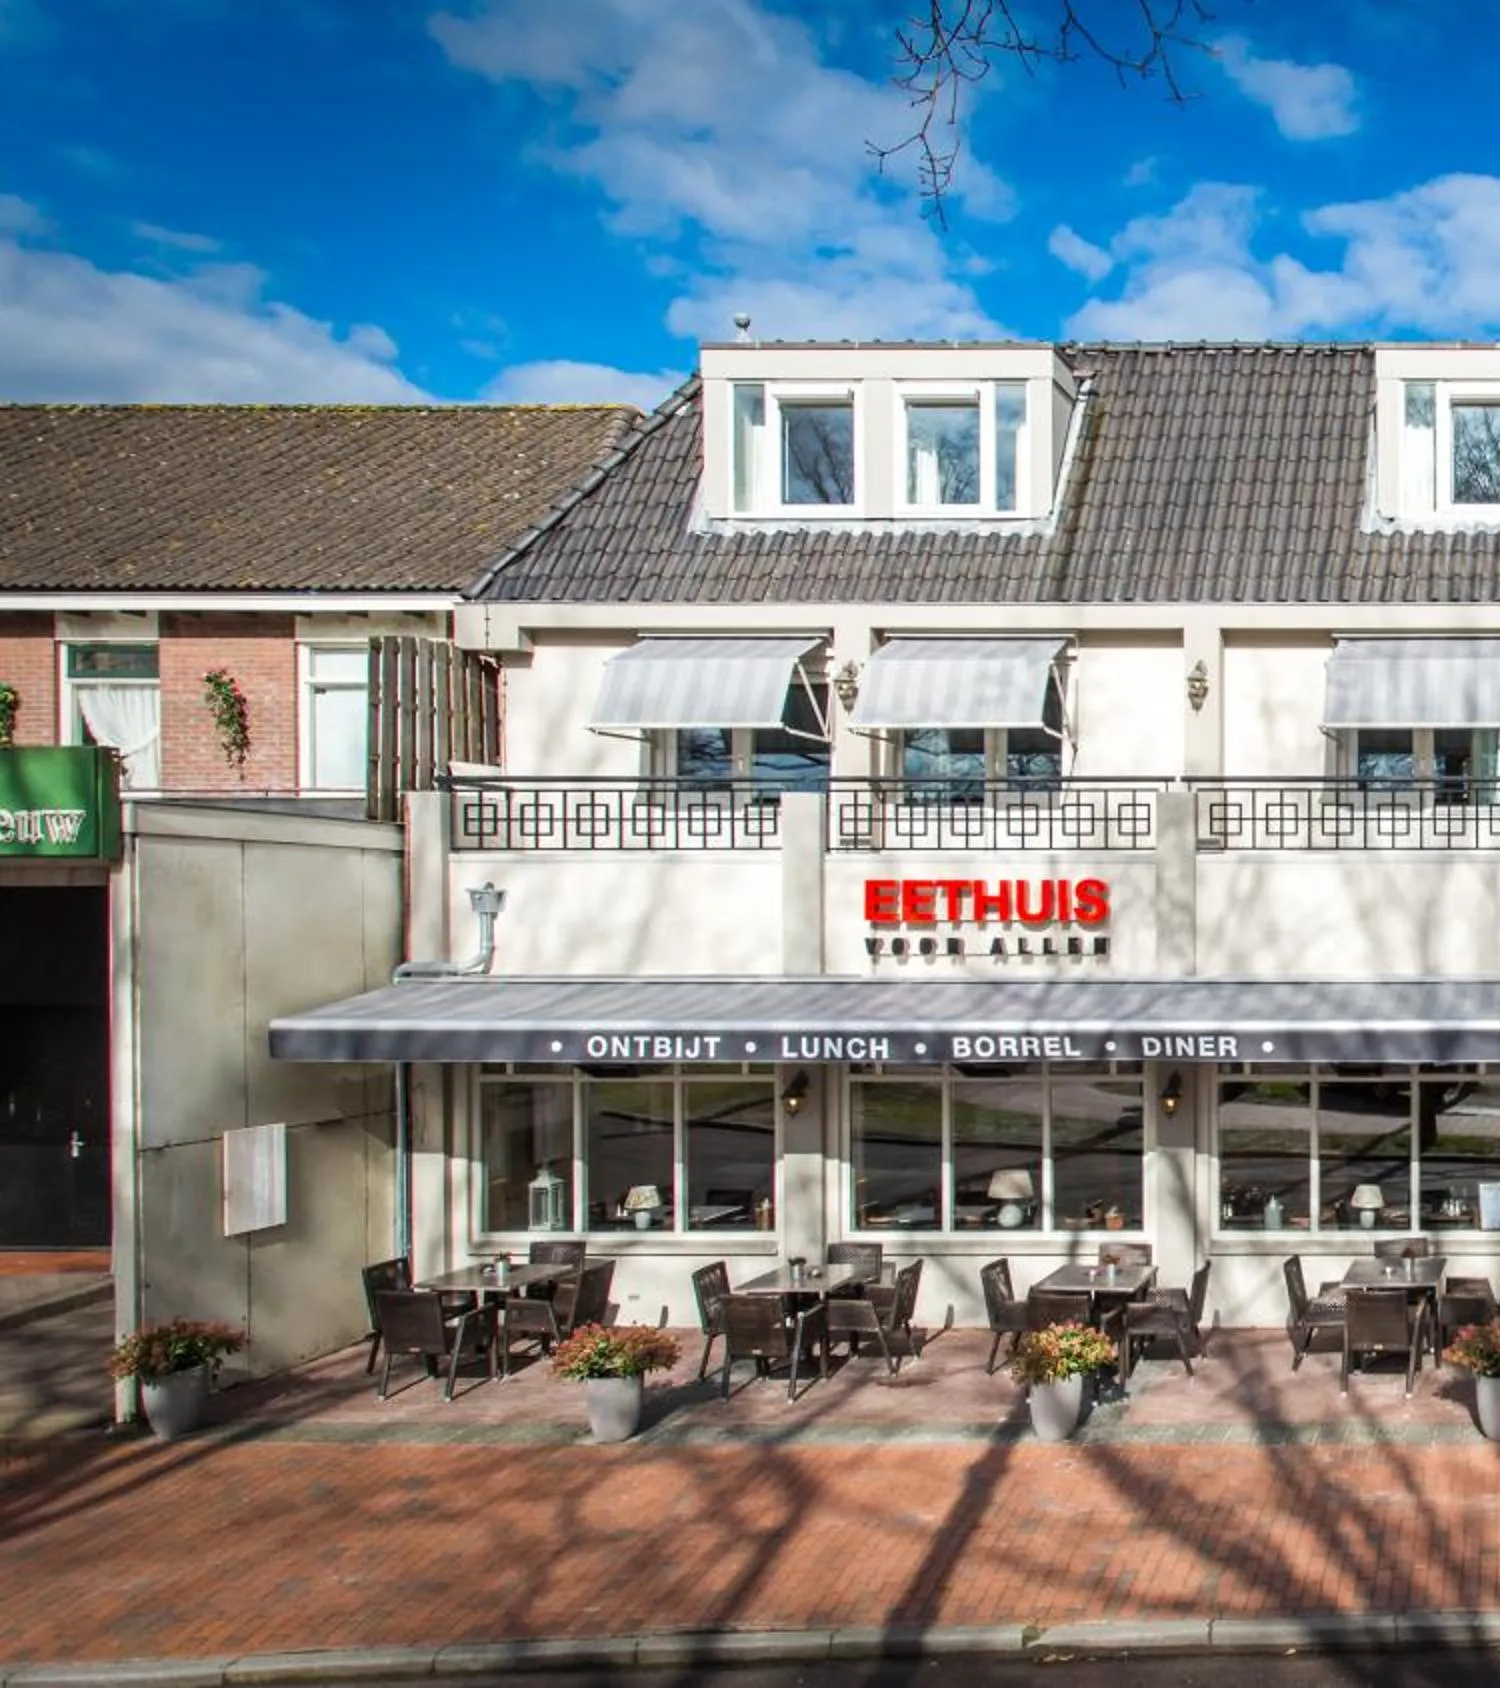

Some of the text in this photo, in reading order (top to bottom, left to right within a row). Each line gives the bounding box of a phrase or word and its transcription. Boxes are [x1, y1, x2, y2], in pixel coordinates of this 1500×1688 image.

[864, 878, 1111, 923] EETHUIS
[587, 1035, 1238, 1060] ONTBIJT LUNCH BORREL DINER
